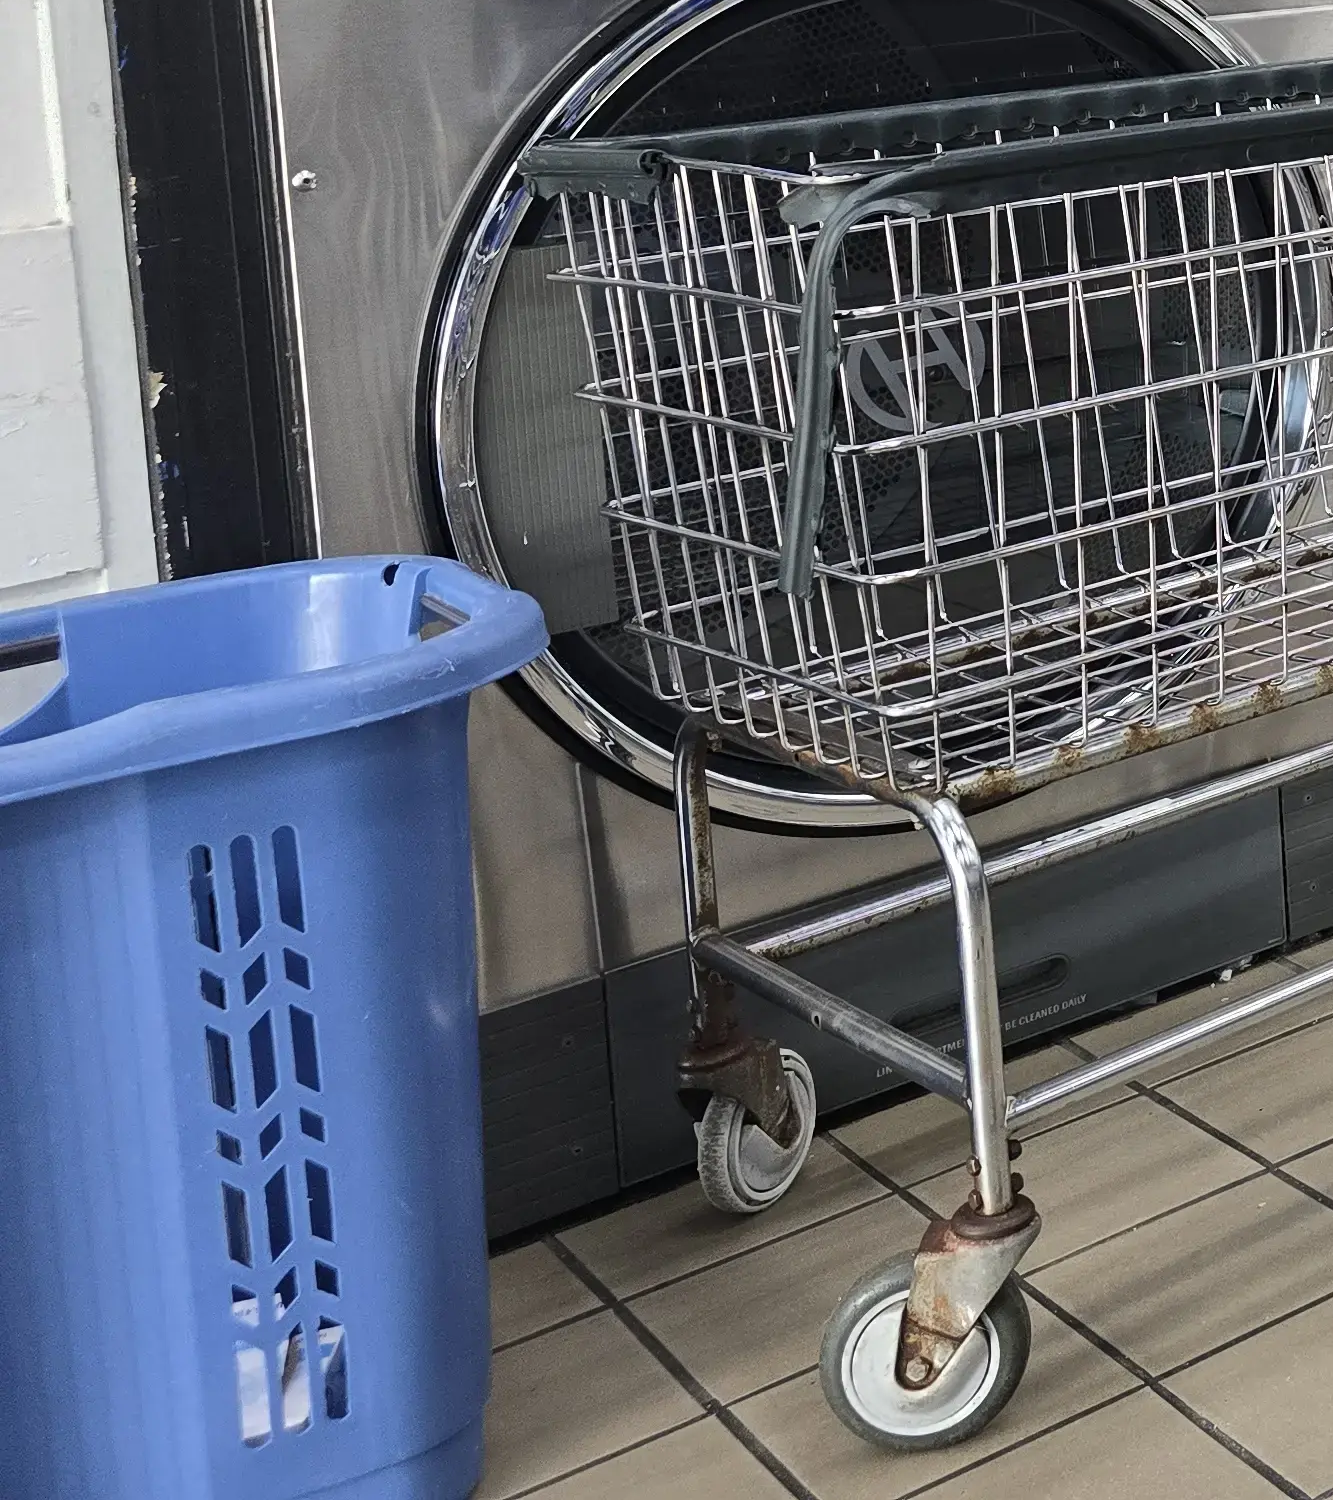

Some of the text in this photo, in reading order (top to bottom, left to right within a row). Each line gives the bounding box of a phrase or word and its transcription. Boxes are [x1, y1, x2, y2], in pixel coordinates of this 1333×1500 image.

[1005, 994, 1088, 1031] BE CLEANED DAILY
[876, 1065, 893, 1078] LIN
